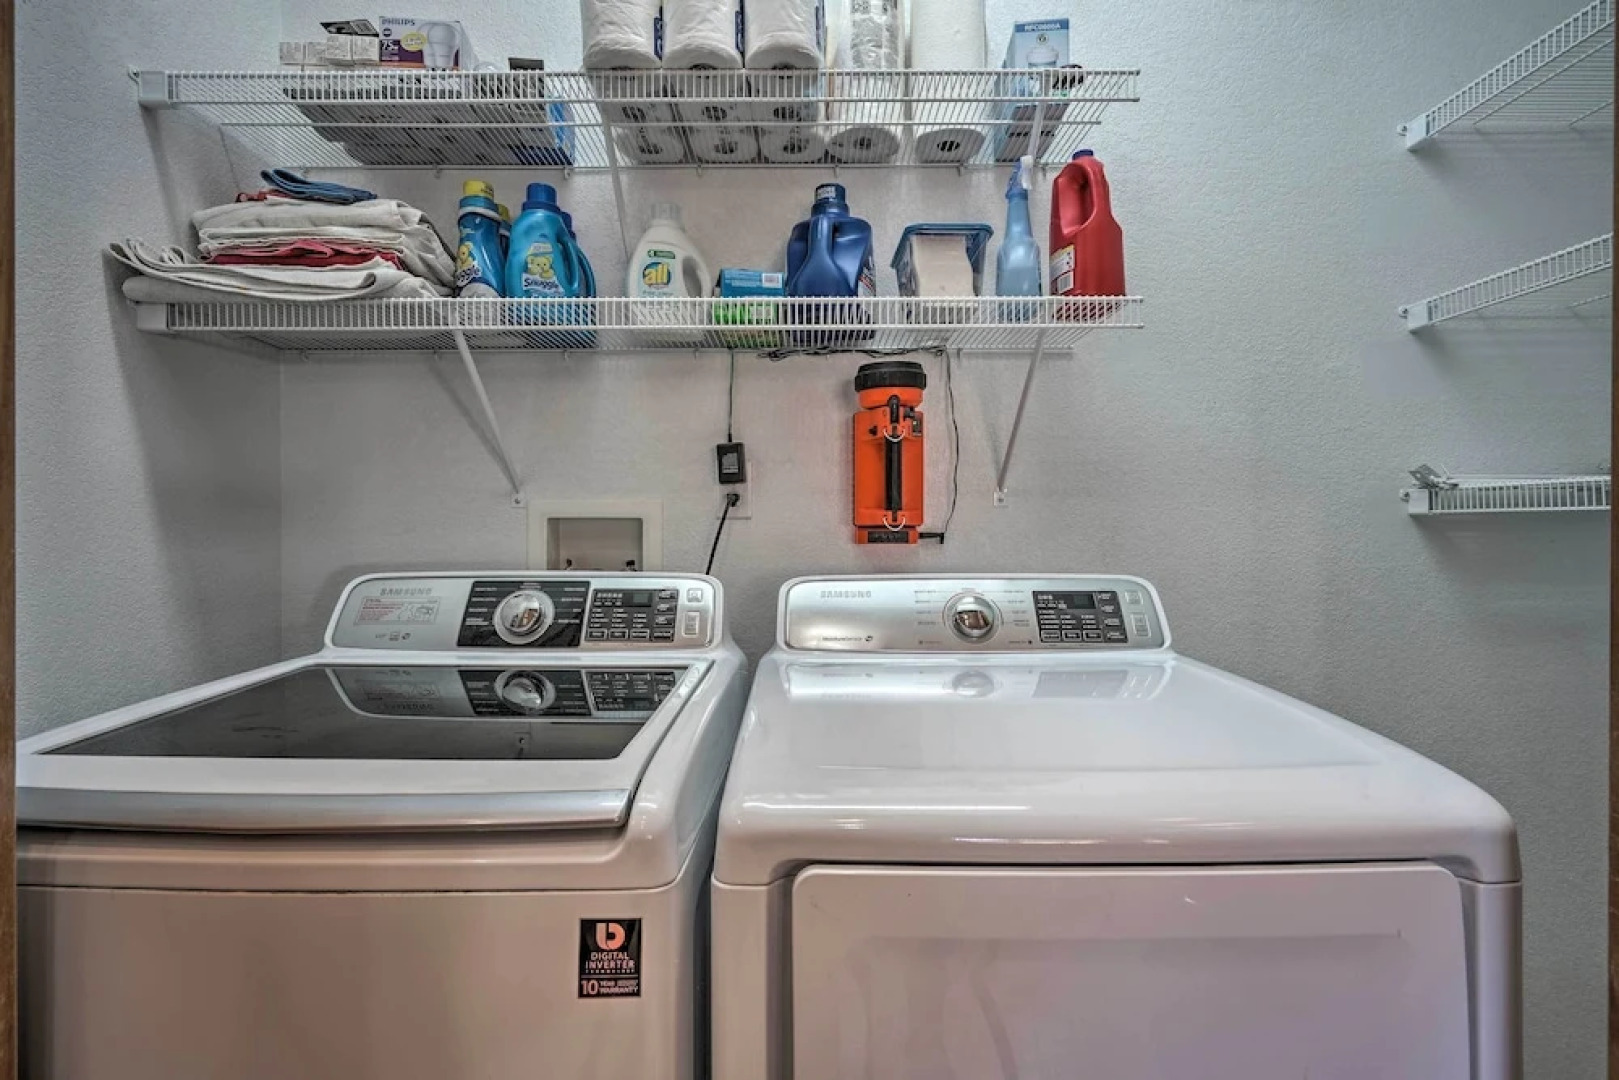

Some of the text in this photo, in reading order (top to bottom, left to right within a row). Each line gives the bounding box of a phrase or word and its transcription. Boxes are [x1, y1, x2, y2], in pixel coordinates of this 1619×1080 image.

[381, 17, 415, 26] PHILIPS
[644, 263, 668, 286] all
[380, 587, 432, 596] SAMSUNG
[820, 590, 871, 598] SAMSUNG
[590, 951, 629, 960] DIGITAL
[585, 960, 635, 969] INVERTER
[581, 980, 599, 995] 10
